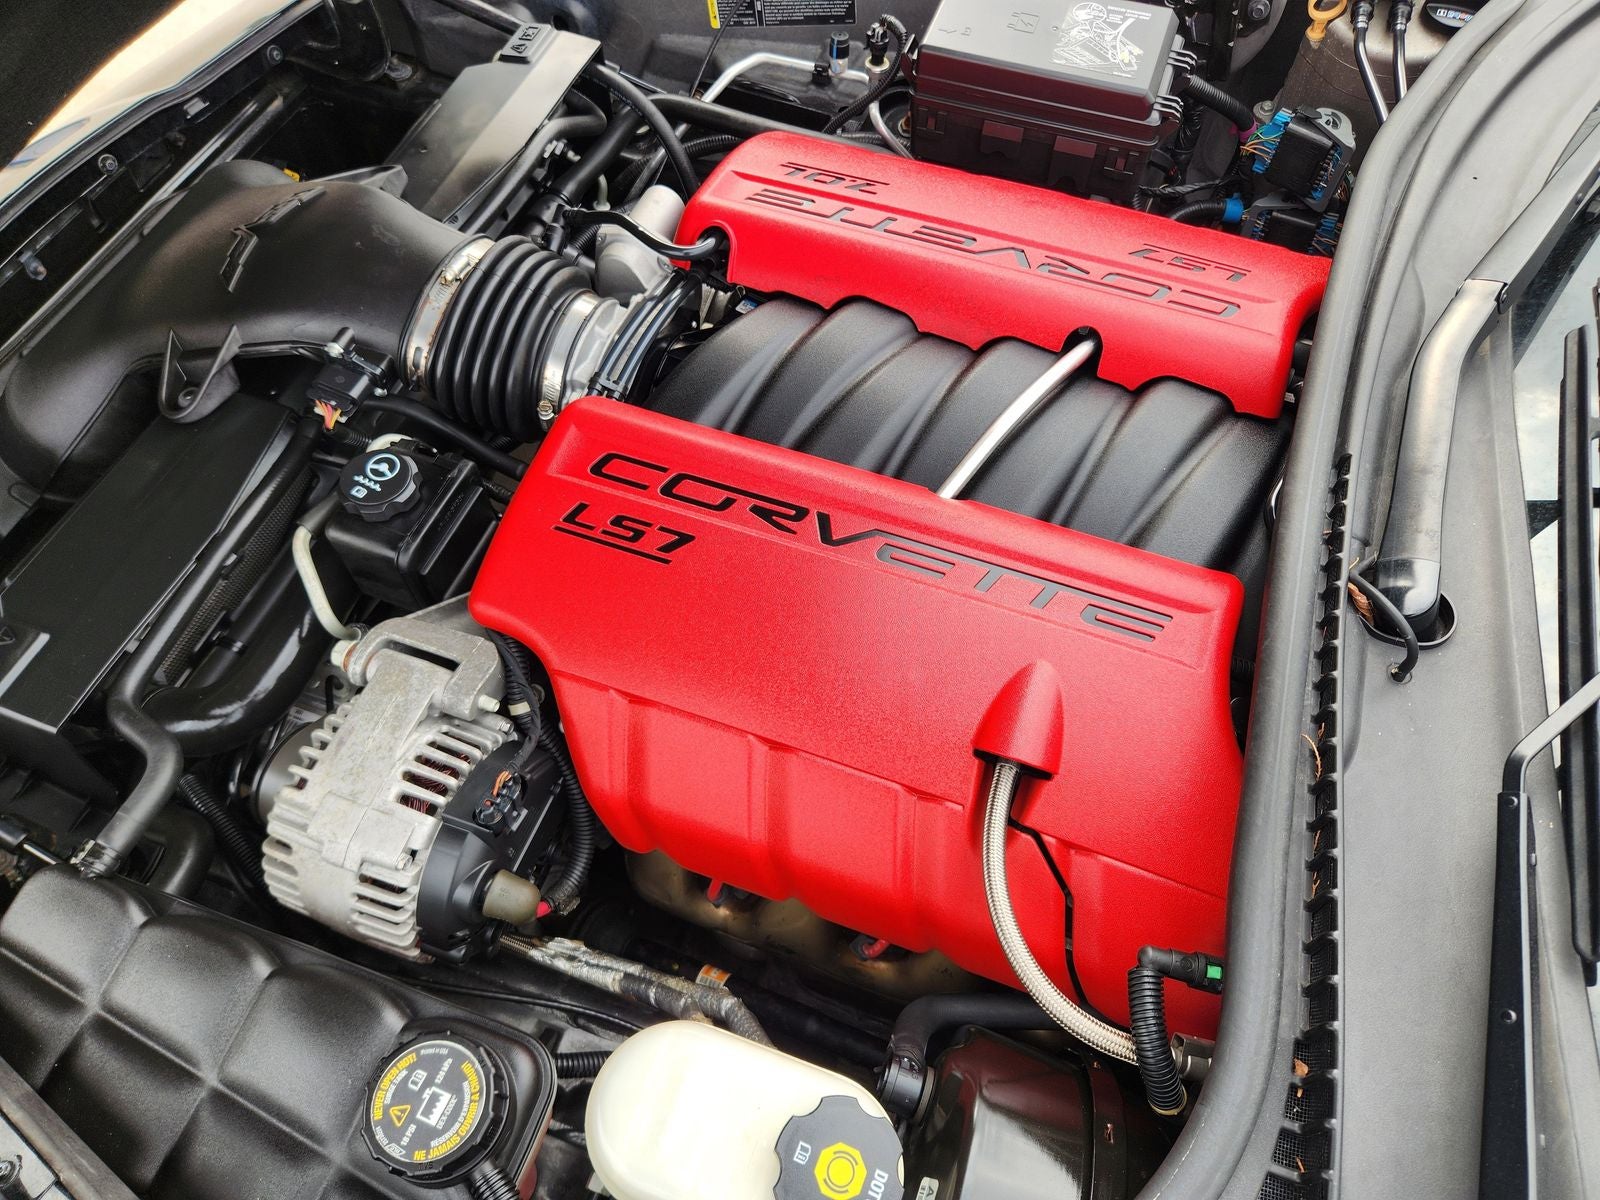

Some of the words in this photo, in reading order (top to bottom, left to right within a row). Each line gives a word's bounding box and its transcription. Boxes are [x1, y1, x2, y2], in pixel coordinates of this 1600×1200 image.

[784, 165, 878, 195] 7.0L
[744, 188, 1241, 318] CORVETTE
[1128, 248, 1248, 283] LS7
[560, 502, 696, 555] LS7
[588, 452, 1174, 643] CORVETTE
[373, 1090, 387, 1120] NEVER
[380, 1066, 400, 1091] OPEN
[396, 1052, 417, 1071] HOT!
[461, 1060, 480, 1093] CHAUD!
[405, 1123, 417, 1138] PSI
[458, 1102, 479, 1136] OUVRIR
[413, 1150, 427, 1161] NE
[428, 1133, 461, 1159] JAMAIS
[868, 1168, 889, 1200] DOT
